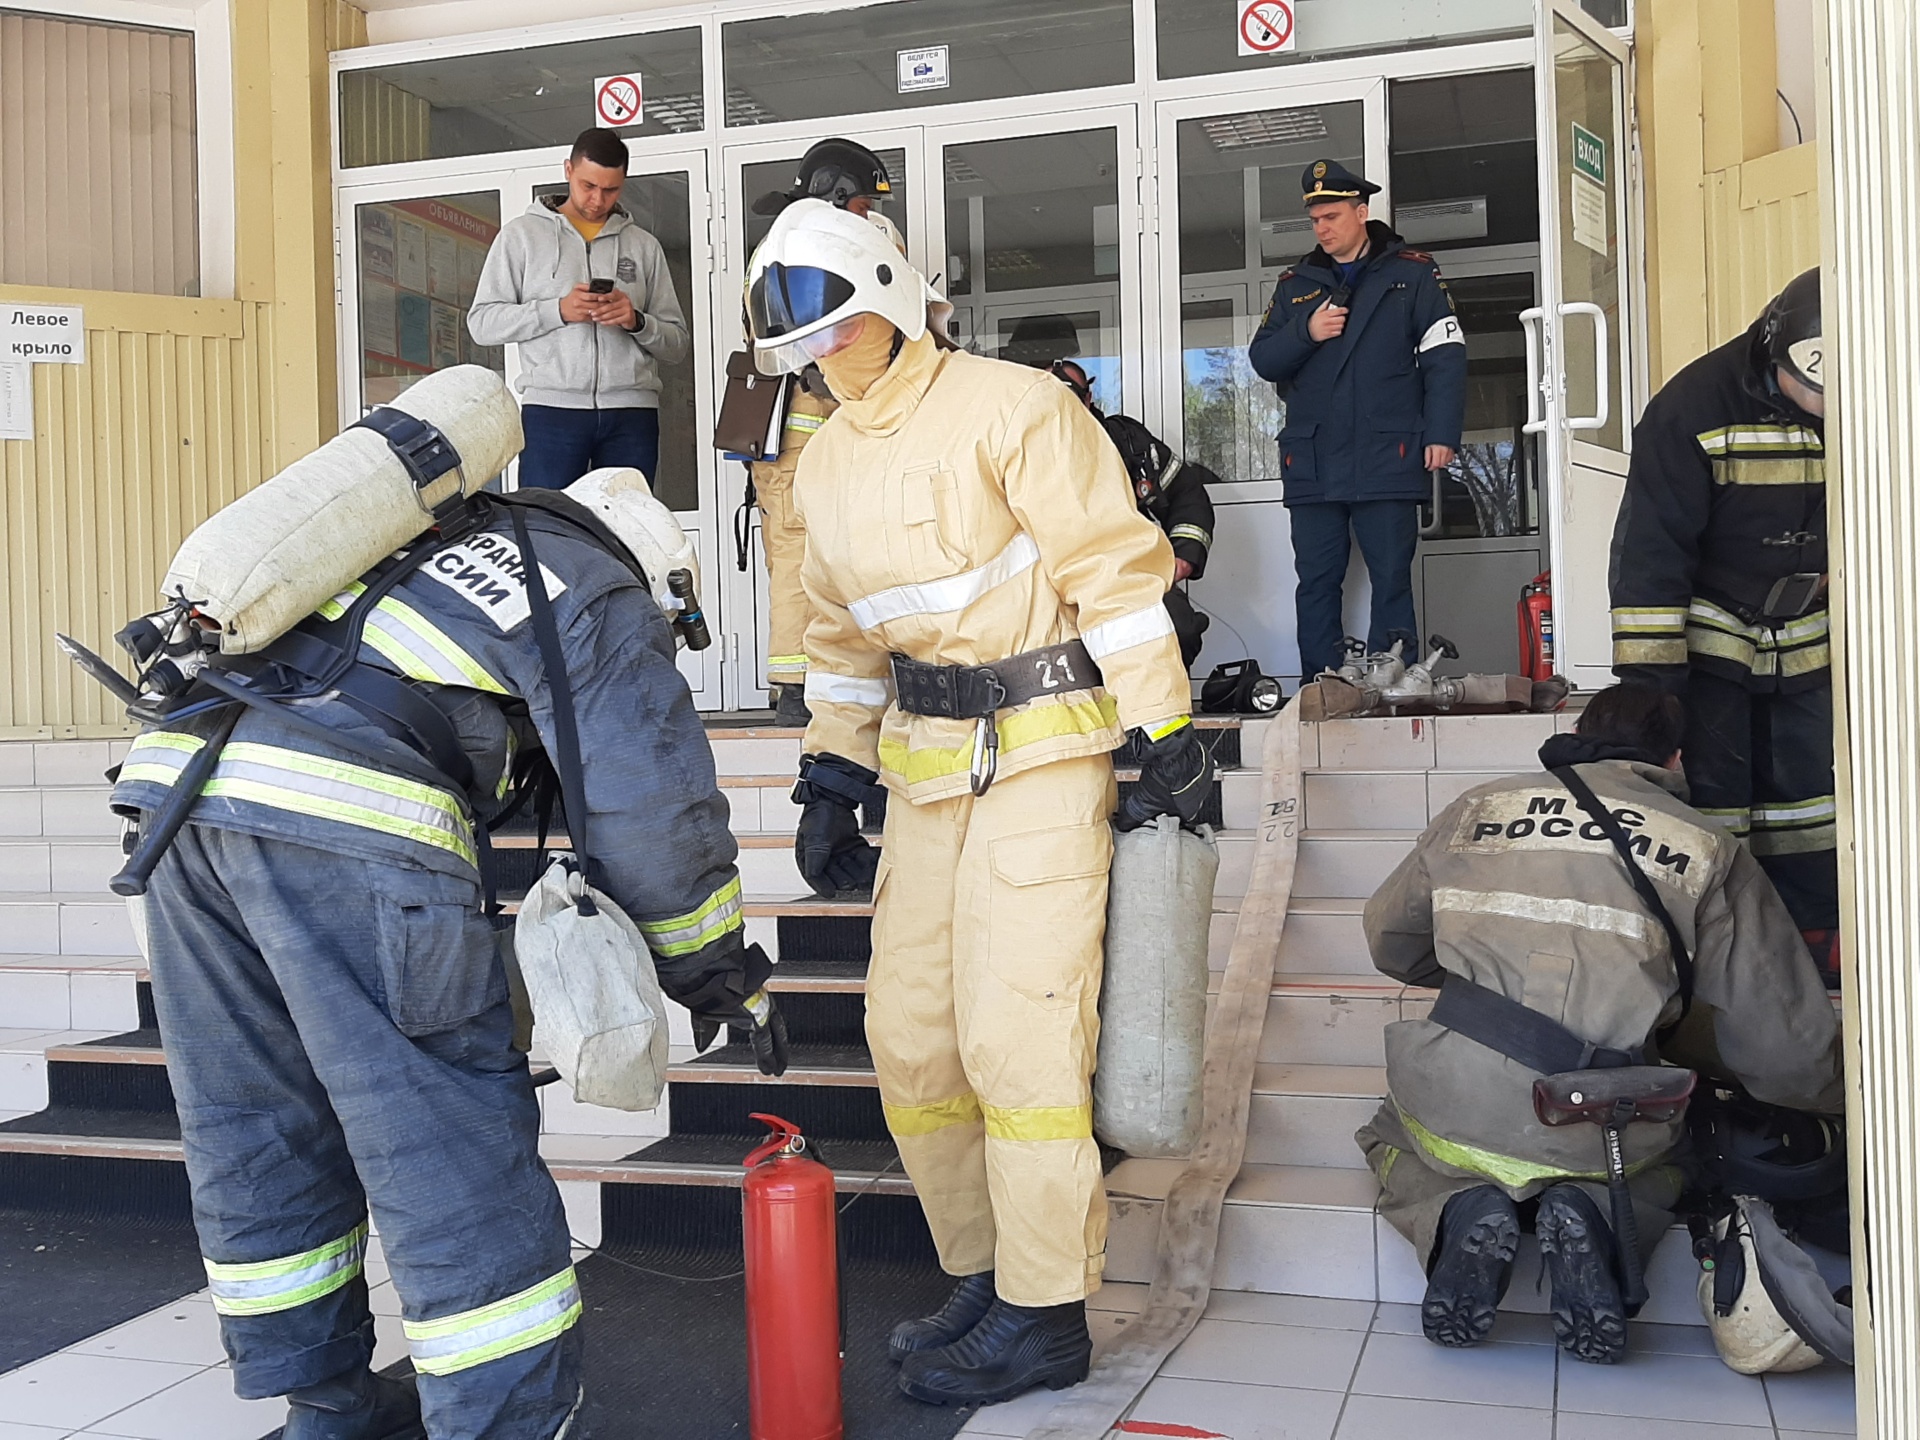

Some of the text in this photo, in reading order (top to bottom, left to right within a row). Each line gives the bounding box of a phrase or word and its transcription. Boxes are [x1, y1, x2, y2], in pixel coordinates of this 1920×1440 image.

[1577, 137, 1602, 174] ВХОД
[429, 202, 487, 237] ОБЪЯВЛЕНИЯ
[11, 311, 69, 326] Левое
[12, 342, 72, 357] крыло
[1806, 350, 1822, 374] 2
[1035, 653, 1076, 689] 21
[1526, 796, 1646, 827] МС
[1472, 818, 1691, 876] РОССИИ
